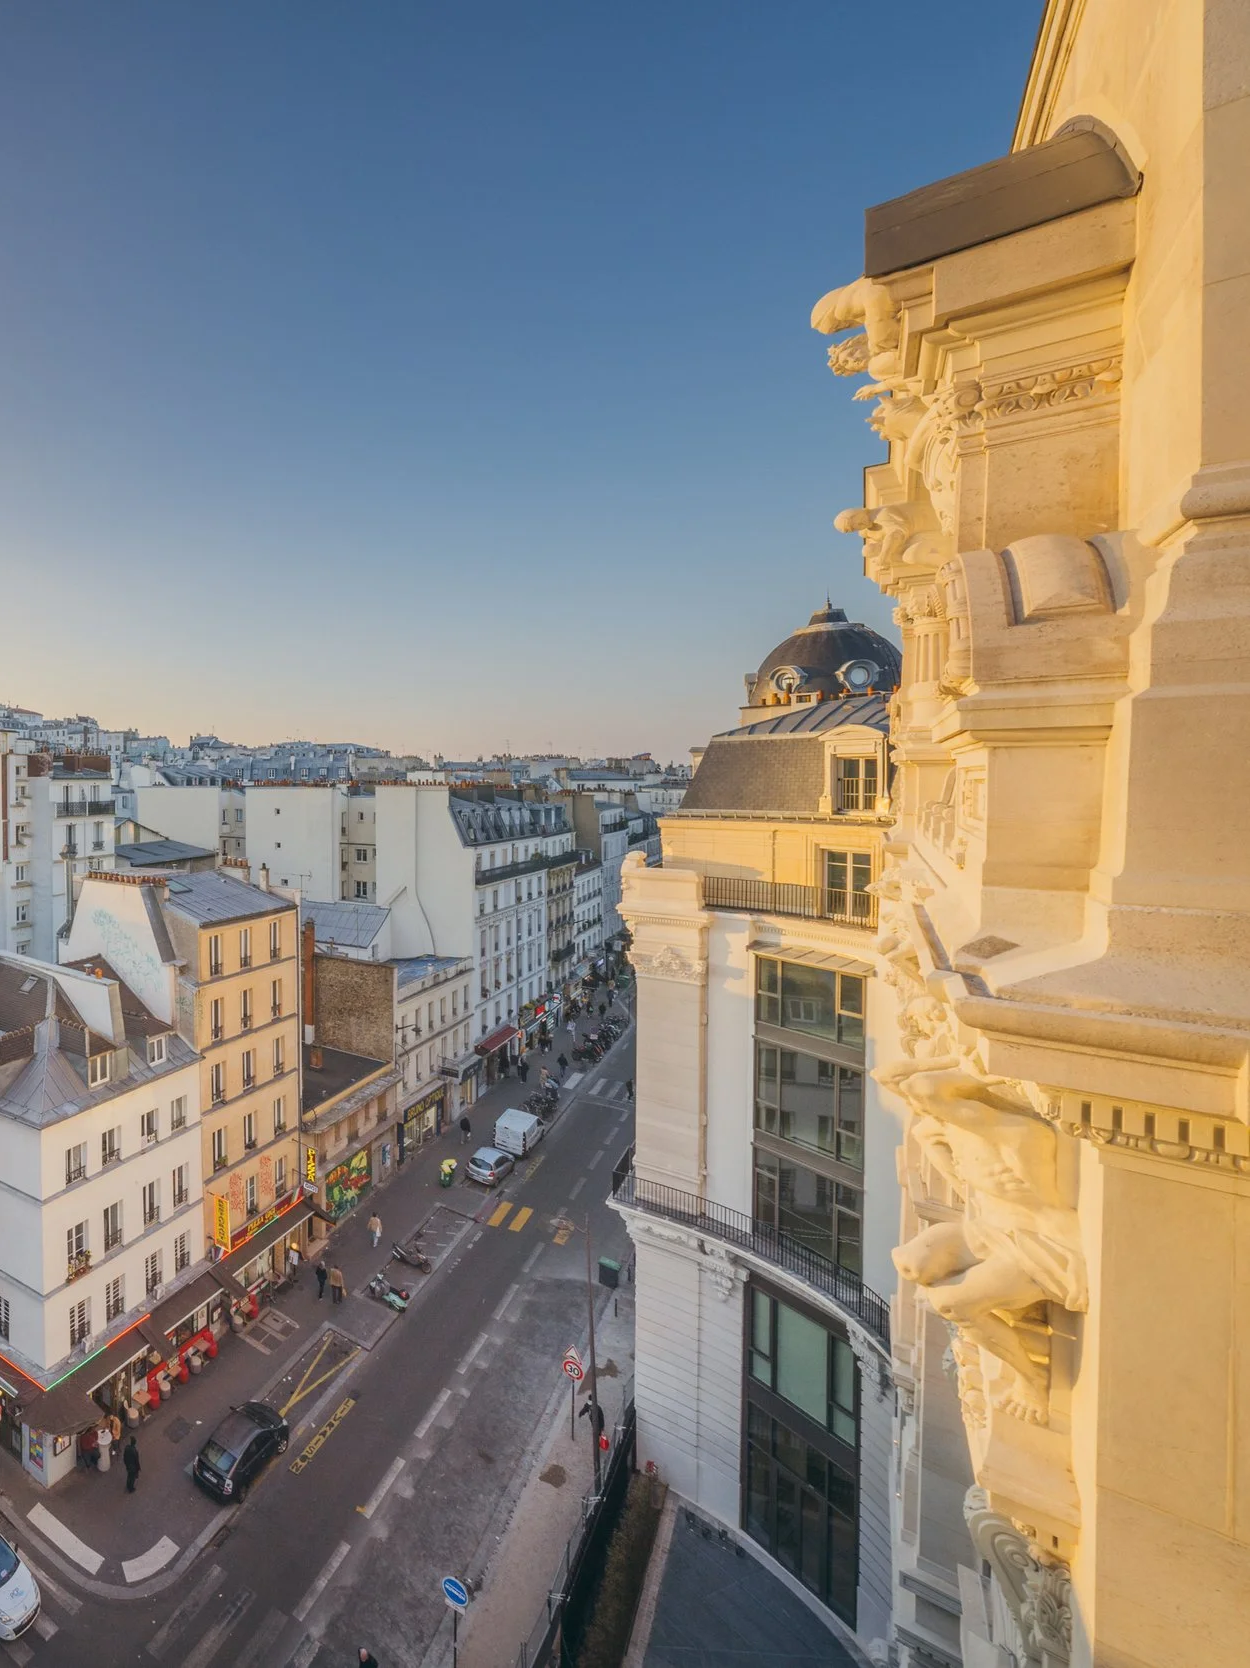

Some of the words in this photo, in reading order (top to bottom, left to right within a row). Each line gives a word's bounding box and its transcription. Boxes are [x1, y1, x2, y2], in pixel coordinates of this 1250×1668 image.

[307, 1147, 316, 1183] PIZZA
[247, 1216, 264, 1232] PIZZA
[568, 1364, 580, 1376] 30
[290, 1398, 354, 1473] LIVRAISON
